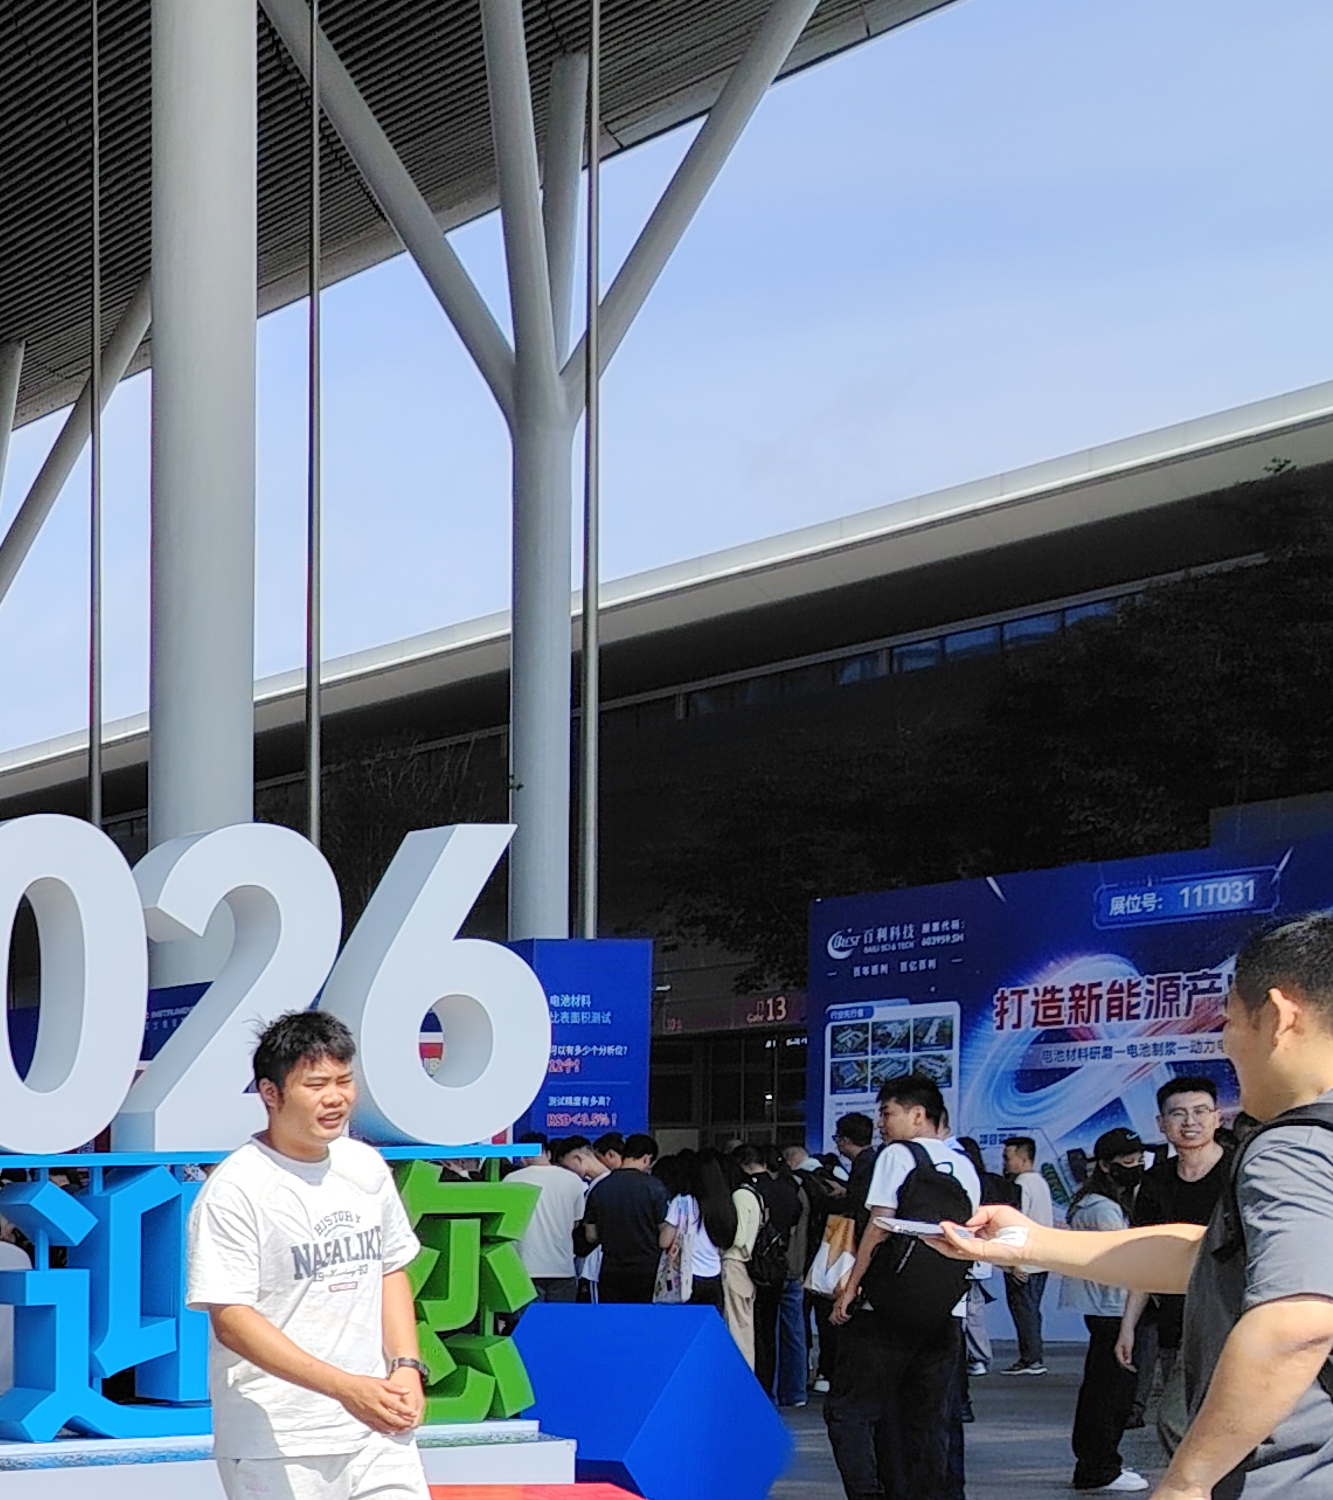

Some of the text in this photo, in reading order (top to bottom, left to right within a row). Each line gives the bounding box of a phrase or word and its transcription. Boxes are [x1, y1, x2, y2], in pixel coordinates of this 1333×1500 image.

[1179, 879, 1256, 910] 11T031
[766, 995, 787, 1021] 13
[994, 969, 1233, 1032] 打造新能源产
[314, 1211, 362, 1237] HISTORY
